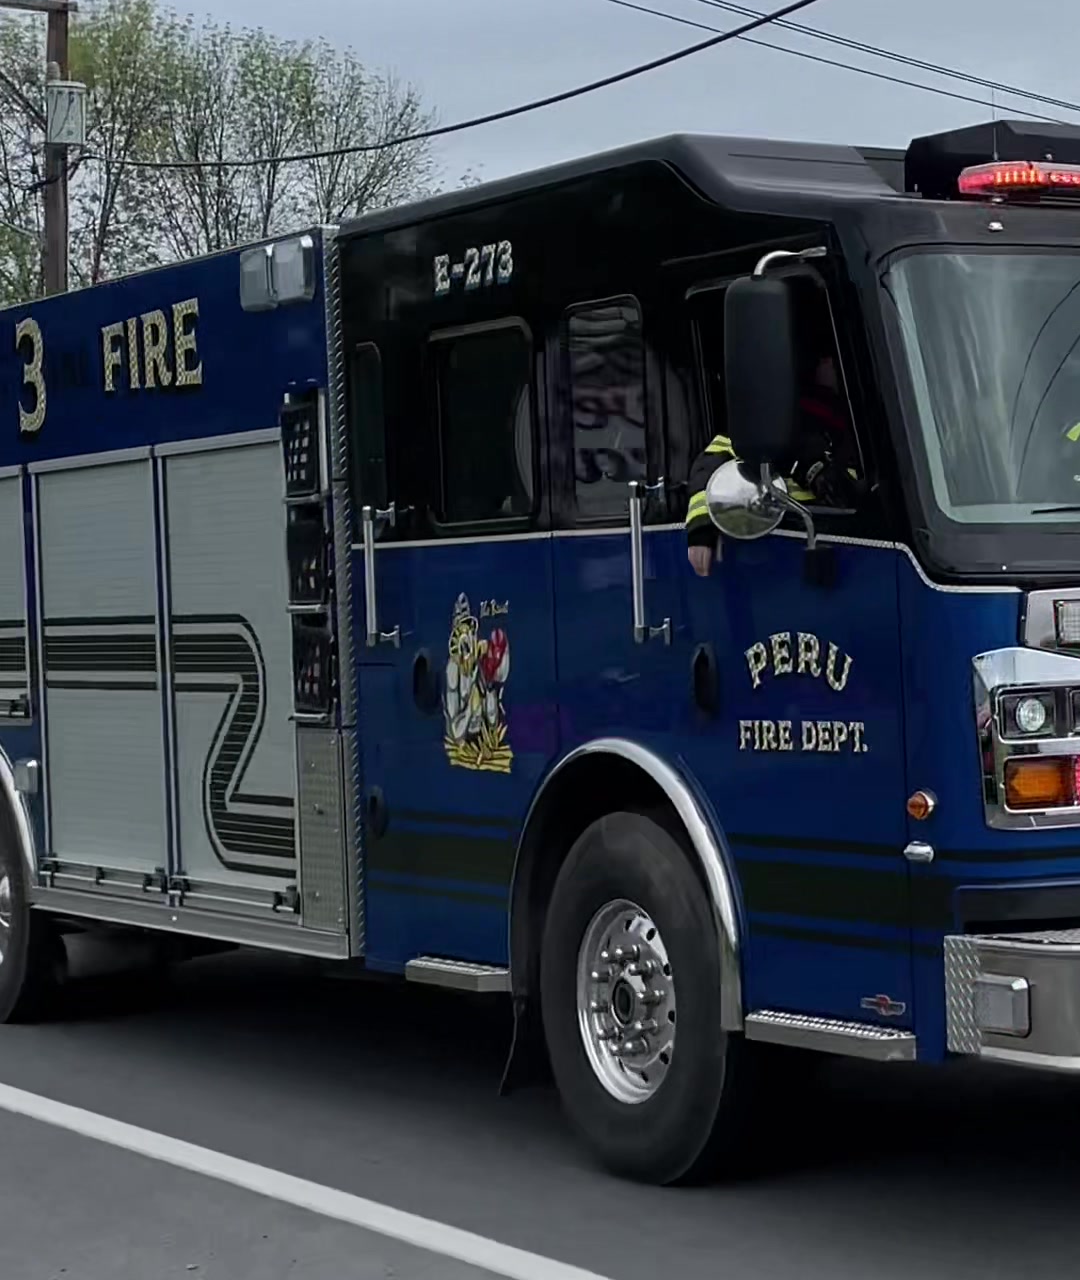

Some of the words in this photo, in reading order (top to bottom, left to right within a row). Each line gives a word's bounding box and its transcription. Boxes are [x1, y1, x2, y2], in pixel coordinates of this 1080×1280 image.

[434, 239, 513, 294] E-273
[101, 297, 202, 392] FIRE
[744, 631, 853, 691] PERU
[739, 719, 794, 751] FIRE
[801, 720, 869, 753] DEPT.
